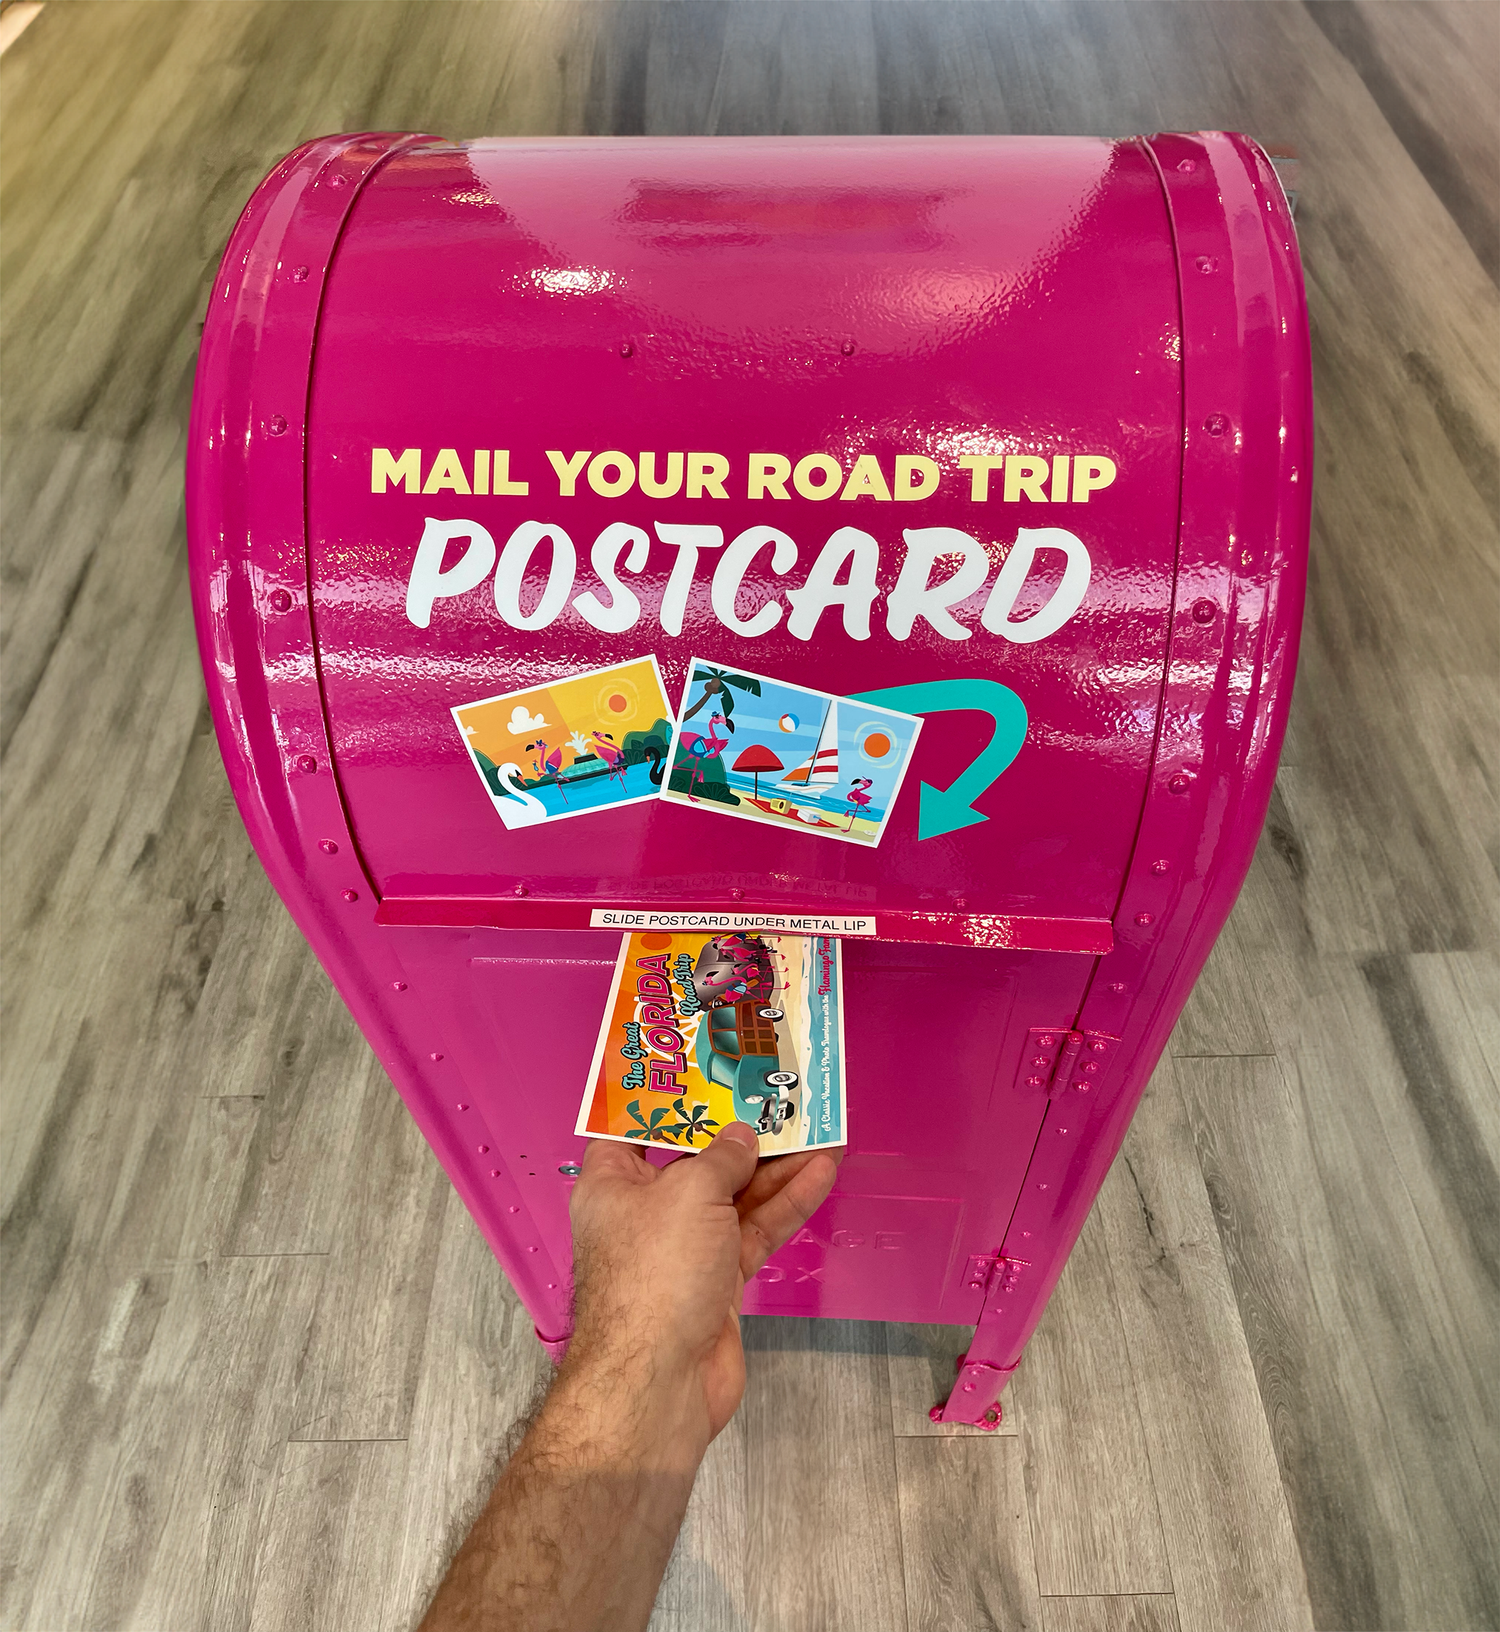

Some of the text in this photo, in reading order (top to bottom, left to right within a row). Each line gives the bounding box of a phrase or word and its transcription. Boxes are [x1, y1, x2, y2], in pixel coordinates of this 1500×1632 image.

[371, 448, 1117, 504] MAIL YOUR ROAD TRIP
[403, 516, 1093, 642] POSTCARD
[602, 913, 867, 931] SLIDE POSTCARD UNDER METAL LIP
[817, 936, 832, 956] Fam
[672, 953, 702, 1017] Road Trip
[817, 955, 834, 995] Flamingo
[821, 994, 829, 1004] the
[821, 1003, 830, 1016] with
[636, 953, 688, 1096] FLORIDA
[620, 1021, 647, 1090] The Great
[820, 1046, 830, 1066] Photo
[821, 1072, 831, 1100] Vacation
[821, 1099, 831, 1122] Classic
[821, 1122, 832, 1132] A
[789, 1228, 906, 1250] AGE
[755, 1265, 826, 1284] OX
